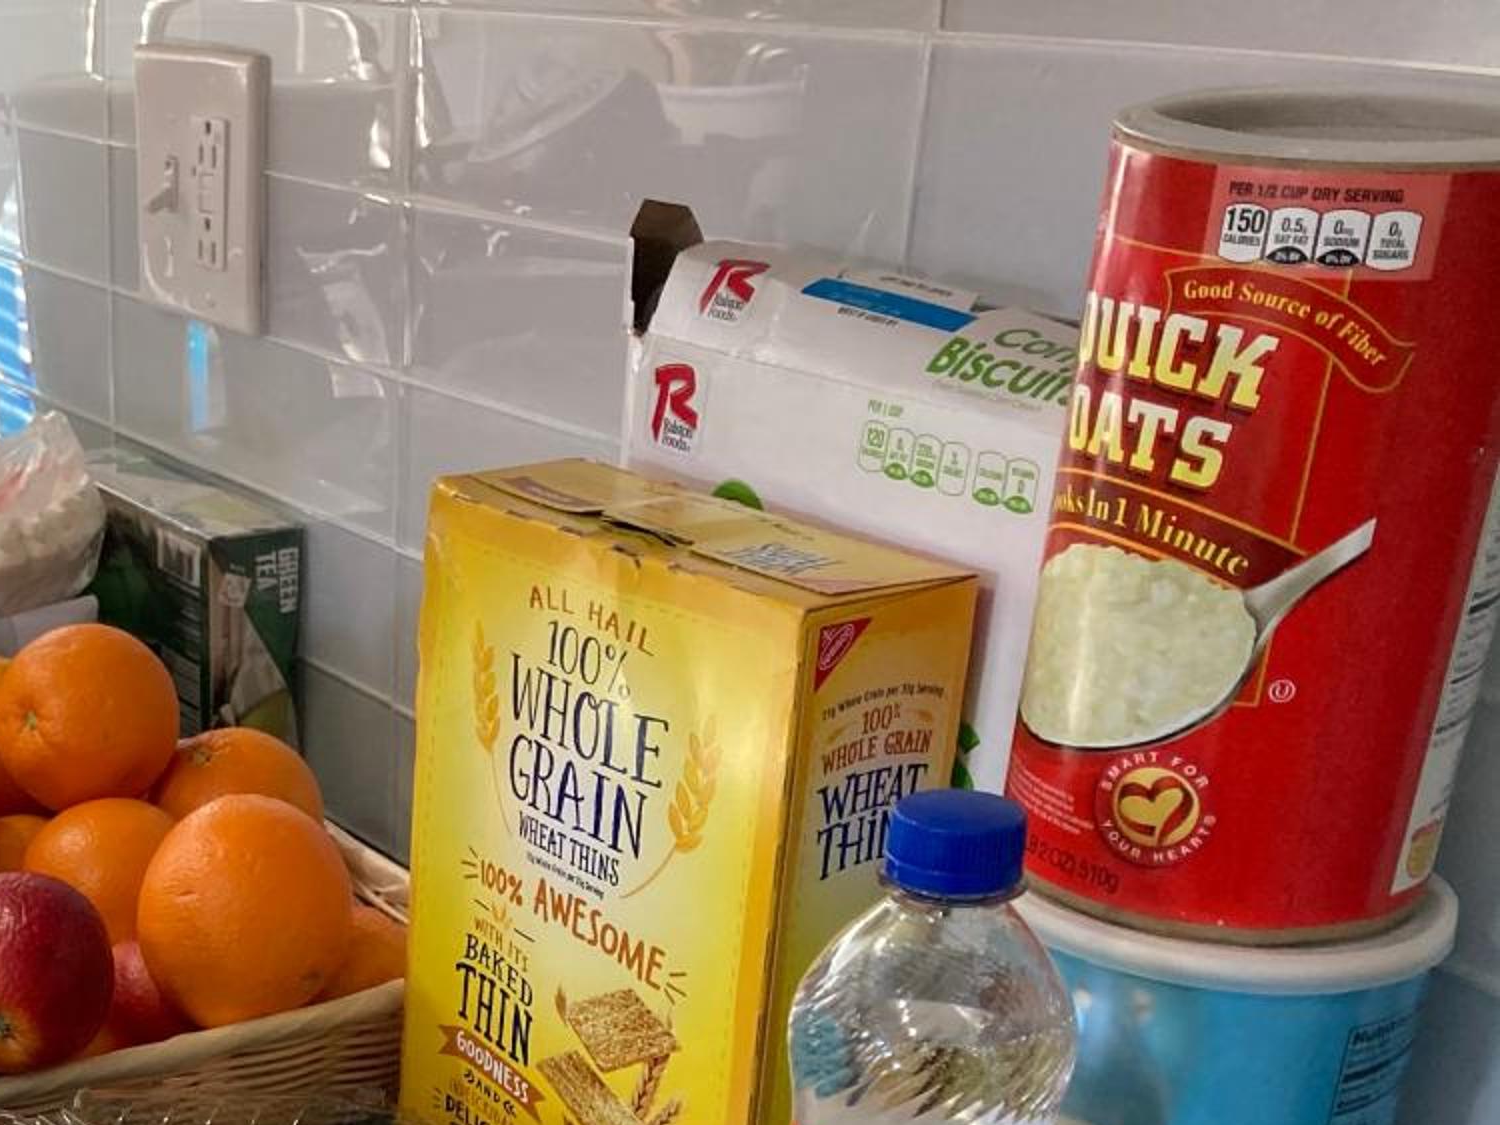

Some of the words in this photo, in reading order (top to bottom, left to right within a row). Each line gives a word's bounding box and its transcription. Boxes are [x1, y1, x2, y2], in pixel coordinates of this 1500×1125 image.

[1226, 208, 1265, 234] 150
[1229, 181, 1253, 196] PER
[1281, 185, 1309, 200] CUP
[1311, 187, 1340, 201] DRY
[1343, 188, 1404, 204] SERVING
[1184, 281, 1234, 299] Good
[1239, 283, 1312, 318] Source
[1315, 308, 1345, 330] of
[1338, 322, 1388, 367] Fiber
[1069, 384, 1234, 489] OATS
[256, 551, 277, 591] TEA
[1135, 502, 1249, 577] Minute
[277, 547, 299, 614] GREEN
[529, 584, 575, 614] ALL
[589, 600, 655, 657] HAIL
[546, 619, 632, 700] 100%
[510, 651, 670, 790] WHOLE
[822, 736, 879, 778] WHOLE
[885, 729, 934, 756] GRAIN
[861, 703, 902, 736] 100%
[508, 732, 649, 860] GRAIN
[816, 763, 929, 824] WHEAT
[1100, 750, 1158, 792] SMART
[1171, 756, 1210, 788] FOR
[518, 810, 567, 860] WHEAT
[569, 837, 621, 888] THINS
[1100, 818, 1143, 859] YOUR
[473, 915, 503, 947] WITH
[479, 863, 523, 907] 100%
[533, 877, 668, 991] AWESOME
[463, 933, 535, 1008] BAKED
[455, 961, 533, 1068] THIN
[455, 1030, 531, 1105] GOODNESS
[475, 1079, 501, 1104] AND
